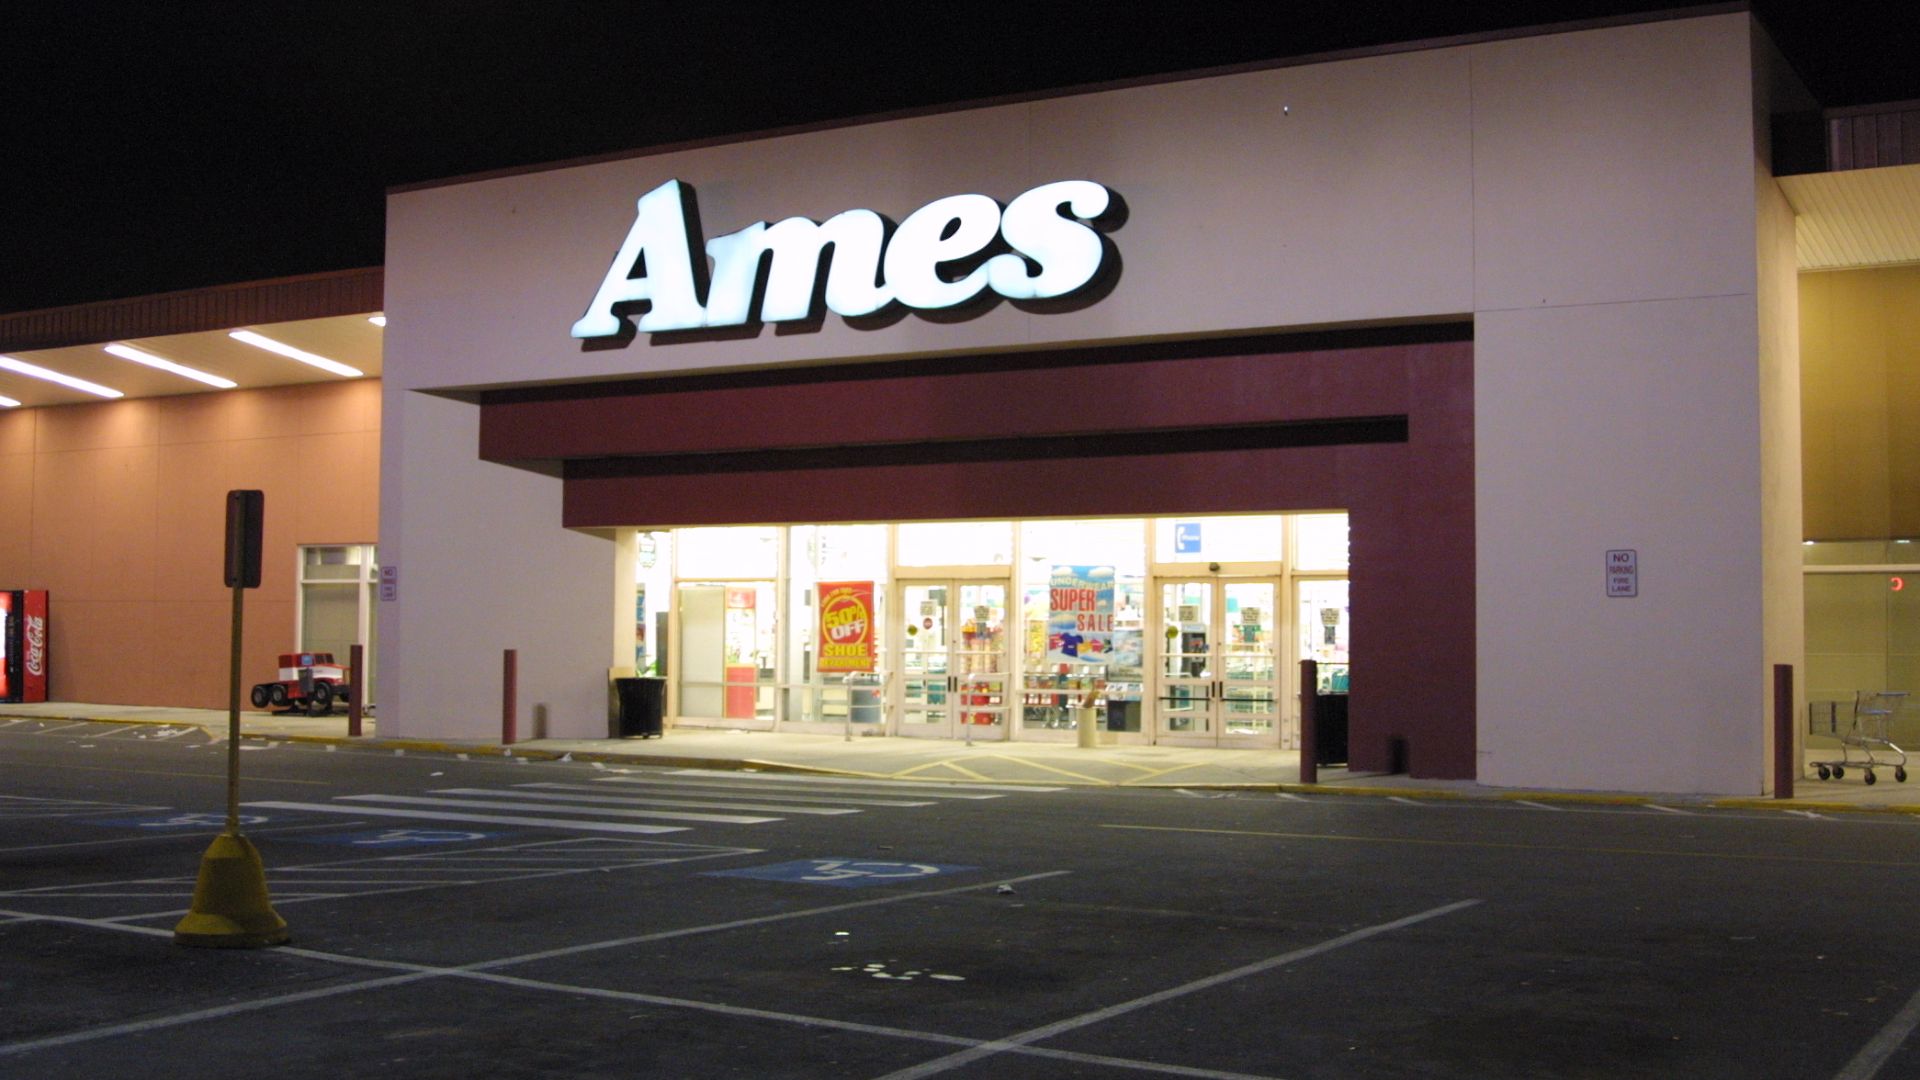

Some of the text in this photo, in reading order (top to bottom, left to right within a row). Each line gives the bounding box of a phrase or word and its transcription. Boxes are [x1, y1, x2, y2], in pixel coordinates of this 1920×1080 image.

[570, 178, 1110, 338] Ames
[1613, 553, 1629, 562] NO
[1050, 588, 1096, 611] SUPER
[824, 604, 866, 629] 50%
[1077, 613, 1114, 632] SALE
[831, 618, 866, 640] OFF
[824, 645, 866, 656] SHOE
